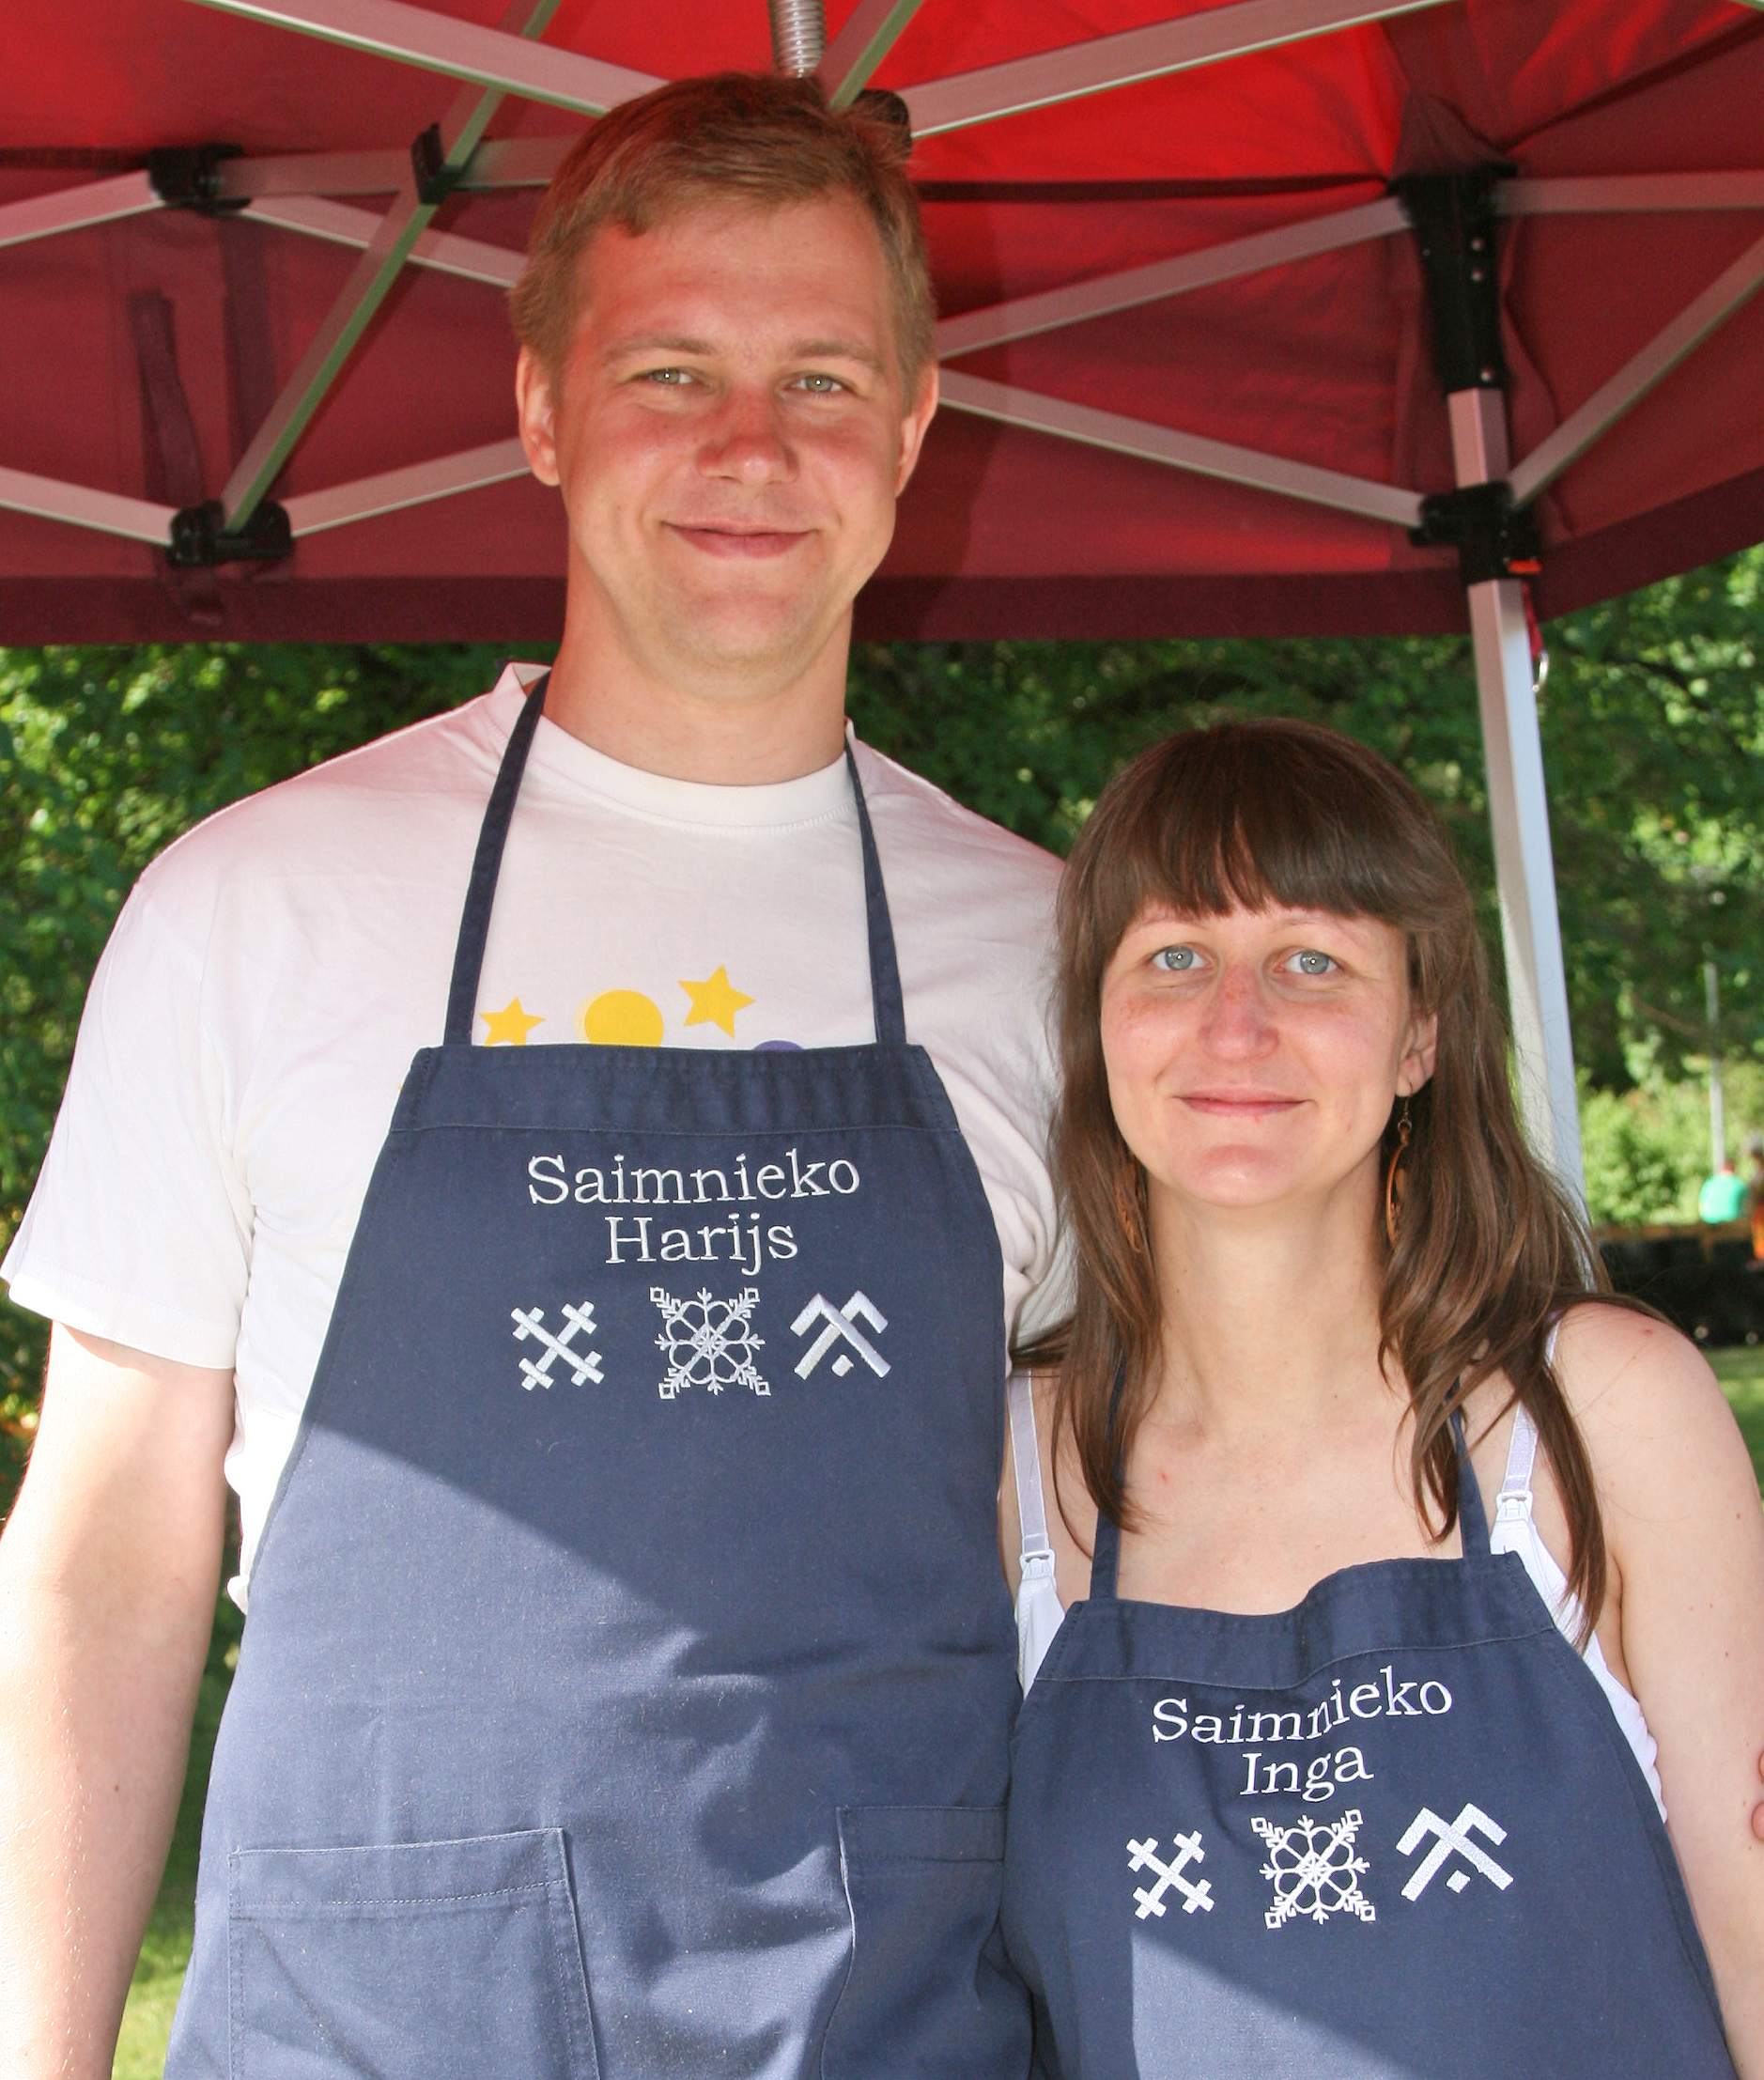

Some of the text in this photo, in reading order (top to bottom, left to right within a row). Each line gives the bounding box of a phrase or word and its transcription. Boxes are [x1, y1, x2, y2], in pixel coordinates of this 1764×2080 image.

[528, 1147, 860, 1205] Saimnieko
[604, 1212, 798, 1277] Harijs
[1152, 1665, 1452, 1745] Saimnieko
[1239, 1746, 1375, 1802] Inga
